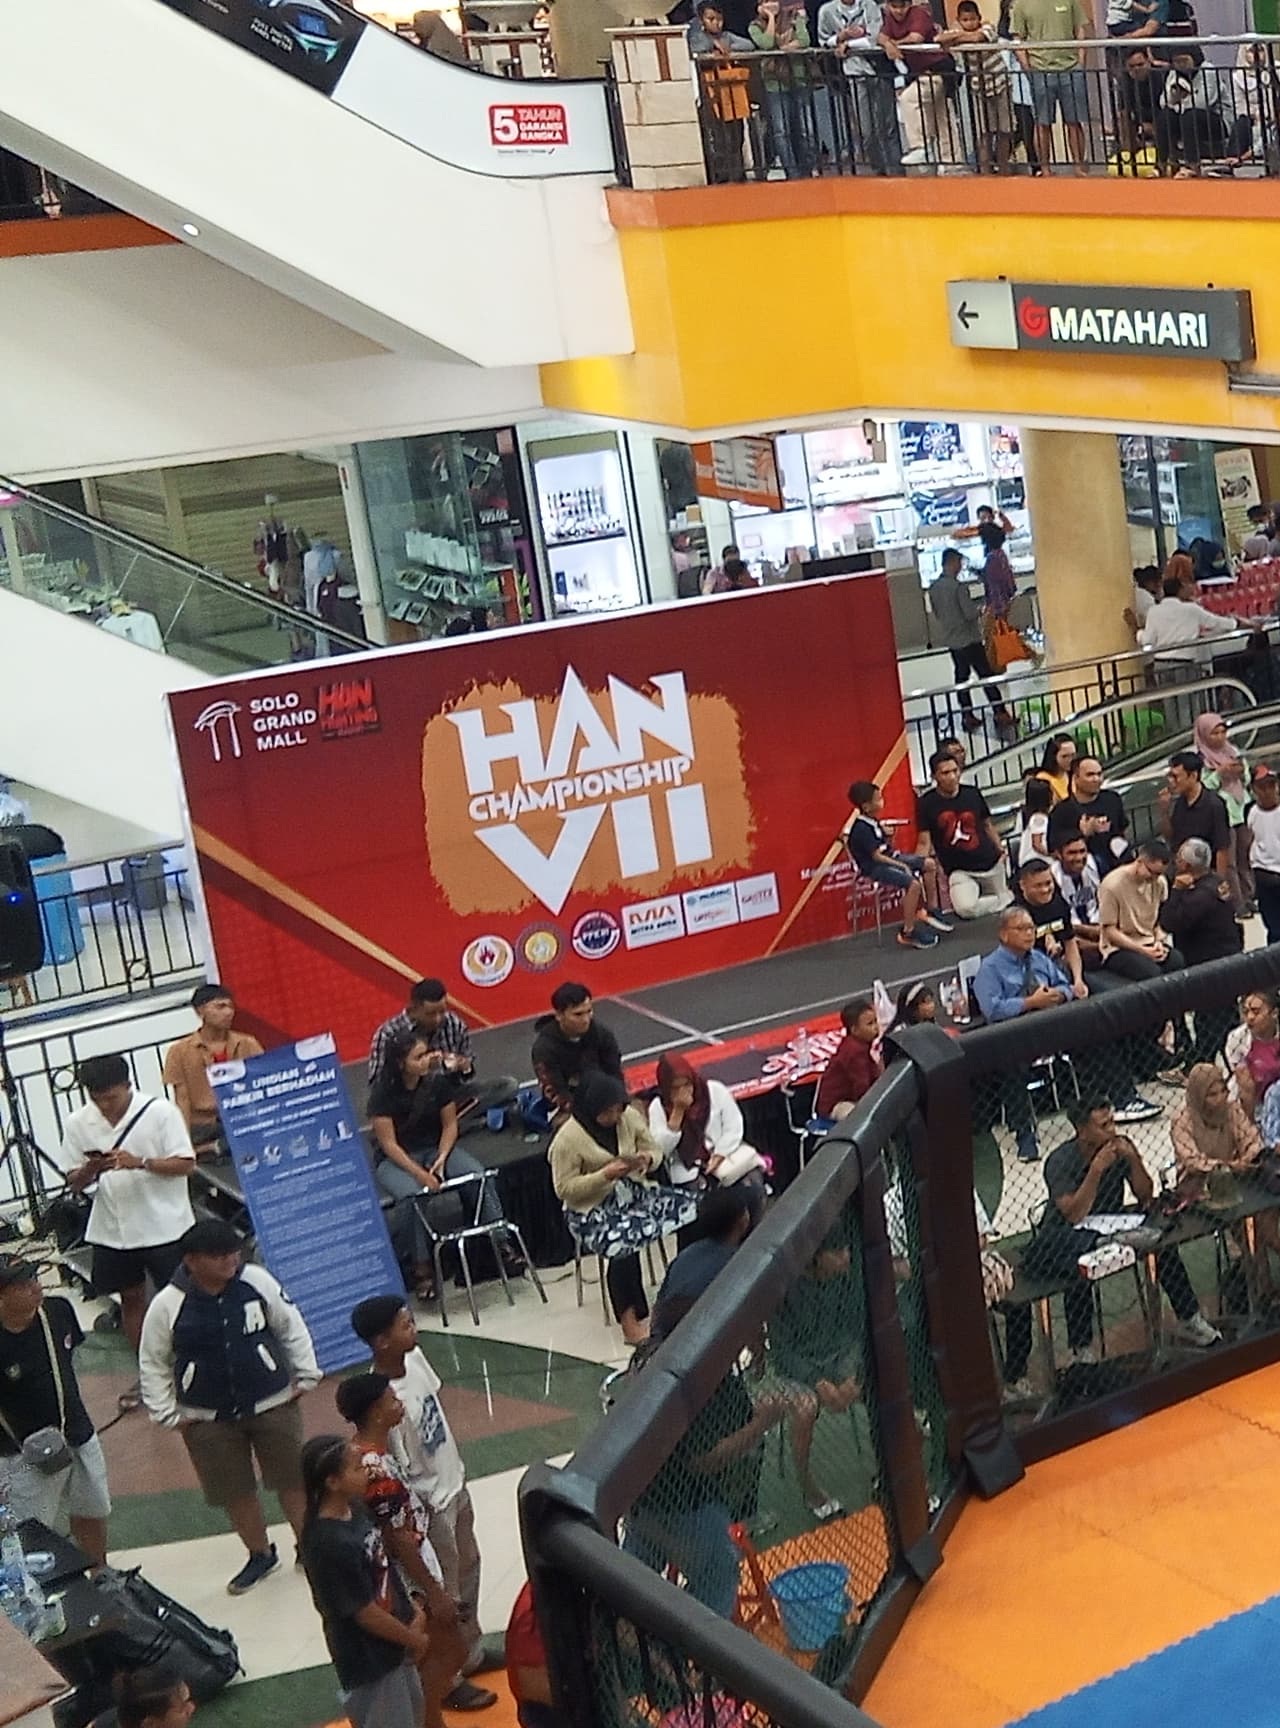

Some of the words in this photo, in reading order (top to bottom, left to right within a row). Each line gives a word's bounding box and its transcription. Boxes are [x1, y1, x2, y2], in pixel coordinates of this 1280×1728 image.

[494, 109, 519, 142] 5
[1049, 307, 1208, 349] MATAHARI
[250, 692, 300, 715] SOLO
[253, 708, 317, 733] GRAND
[256, 731, 308, 752] MALL
[445, 662, 694, 796] HAN
[466, 757, 693, 824] CHAMPIONSHIP
[473, 784, 714, 917] VII
